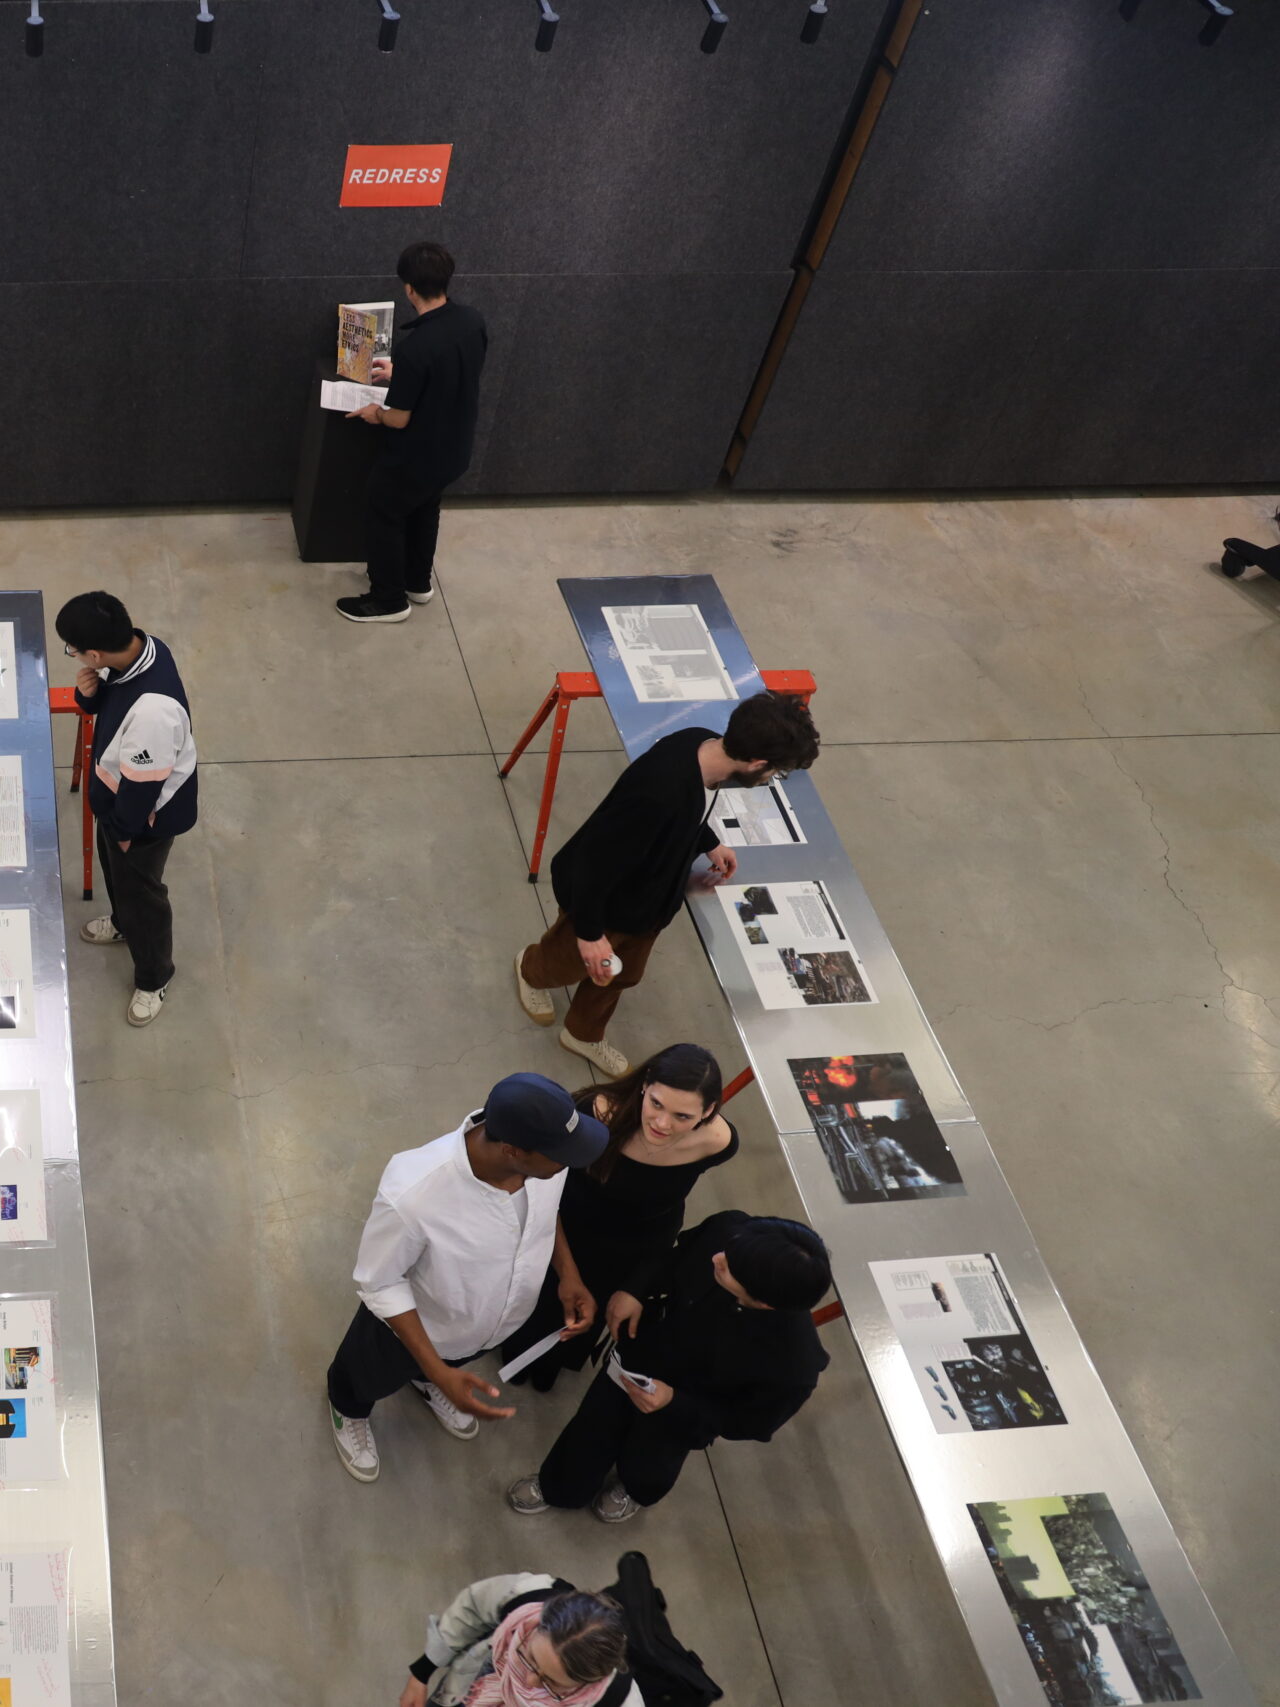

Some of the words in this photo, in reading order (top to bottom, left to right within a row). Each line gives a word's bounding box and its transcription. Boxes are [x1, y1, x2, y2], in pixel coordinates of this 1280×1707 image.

[349, 168, 442, 184] REDRESS
[343, 311, 355, 323] LESS
[342, 323, 372, 339] AESTHETICS
[130, 757, 154, 765] adidas
